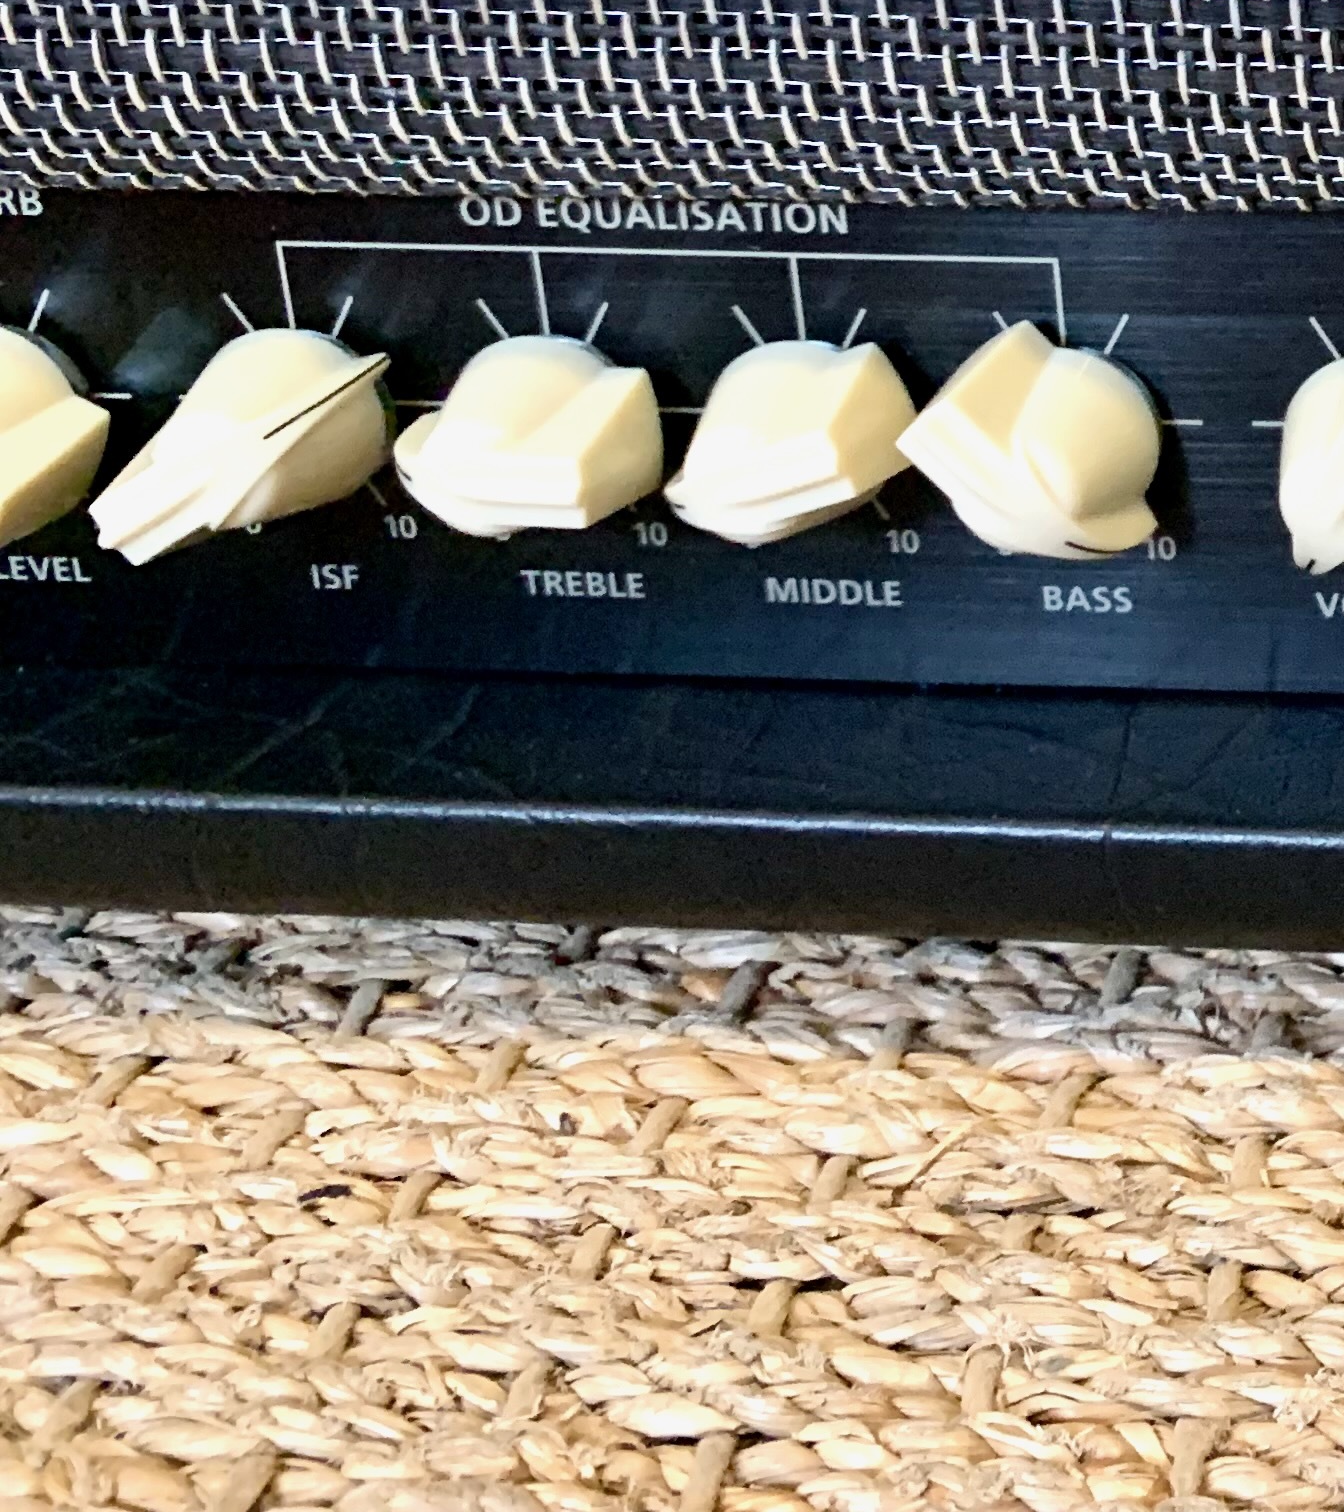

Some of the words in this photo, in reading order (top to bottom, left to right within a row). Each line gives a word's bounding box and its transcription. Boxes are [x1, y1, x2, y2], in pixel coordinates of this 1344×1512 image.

[459, 196, 521, 227] OD
[537, 199, 849, 234] EQUALISATION
[384, 514, 418, 539] 10
[634, 521, 668, 547] 10
[886, 529, 920, 555] 10
[309, 563, 359, 590] ISF
[519, 569, 646, 599] TREBLE
[765, 576, 904, 607] MIDDLE
[1042, 585, 1133, 614] BASS
